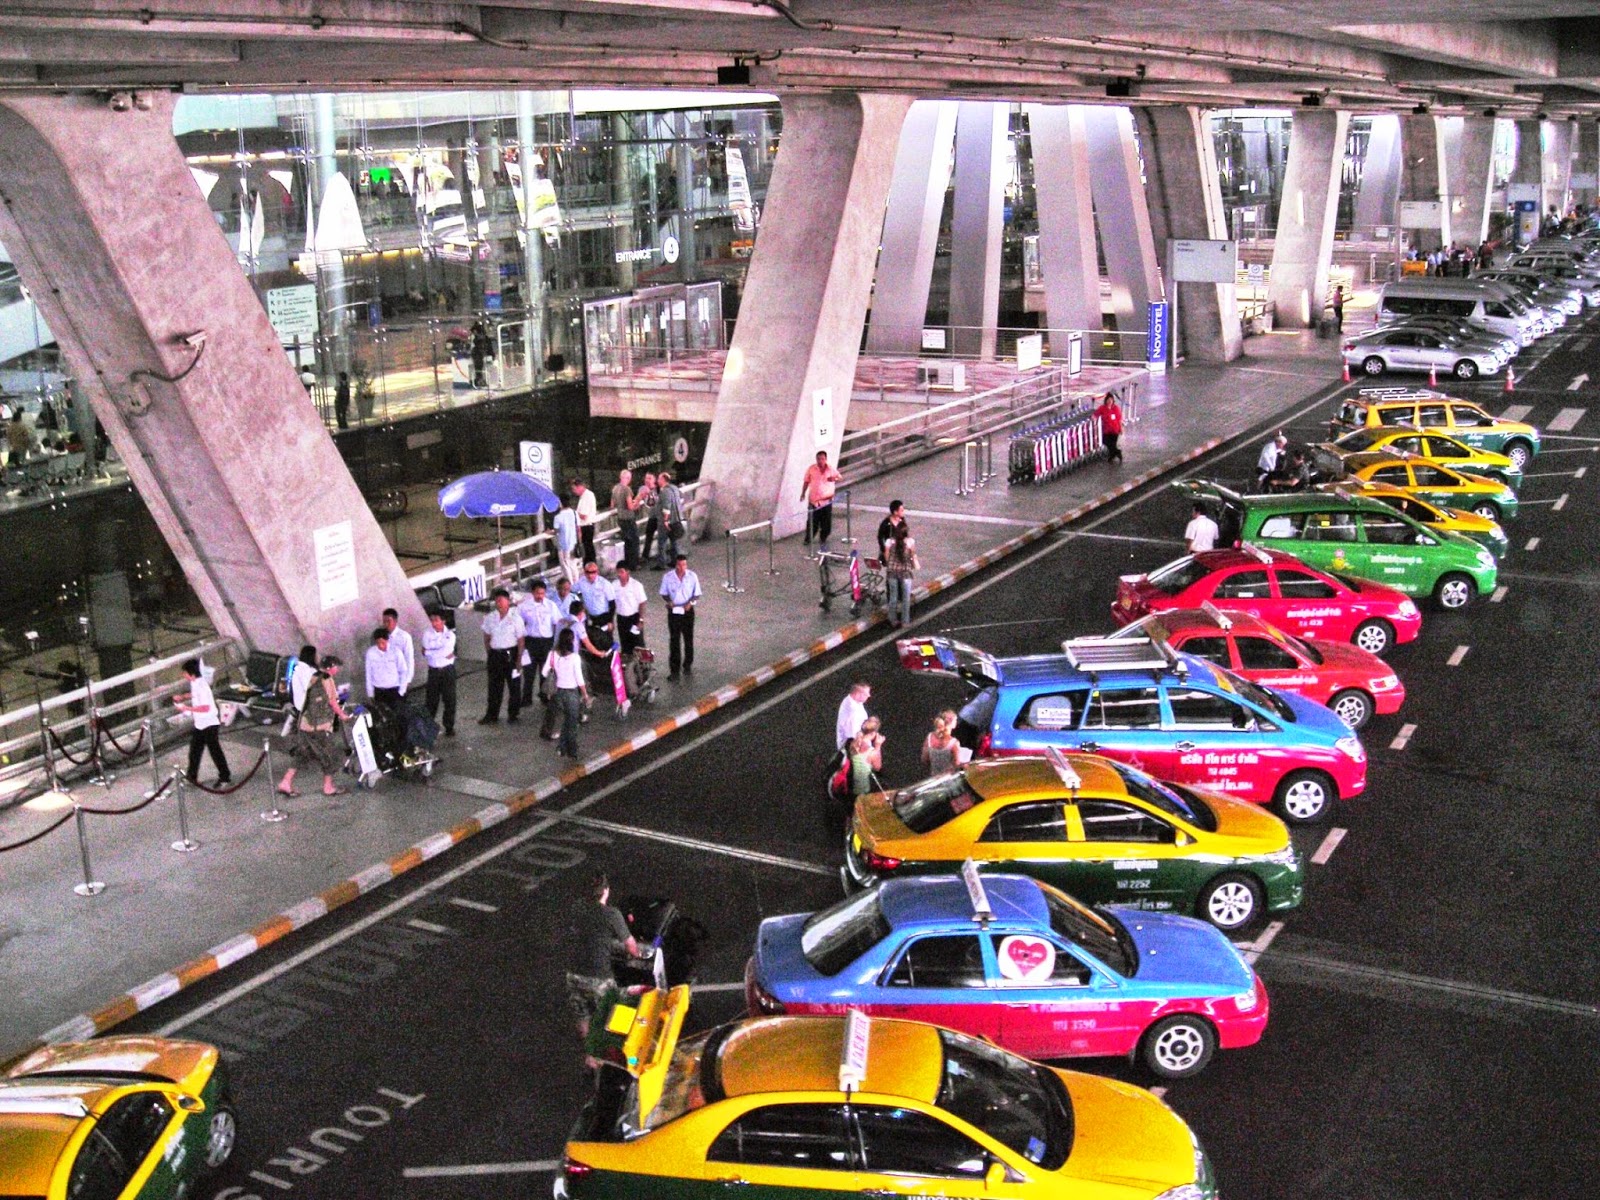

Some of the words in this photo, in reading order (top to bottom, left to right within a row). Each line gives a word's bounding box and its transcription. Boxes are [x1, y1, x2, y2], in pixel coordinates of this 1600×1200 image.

[615, 248, 652, 263] ENTRANCE
[1220, 243, 1228, 254] 4
[1153, 303, 1163, 358] NOVOTEL
[626, 452, 662, 471] ENTRANCE
[460, 574, 484, 603] TAXI
[1129, 879, 1151, 889] 2252
